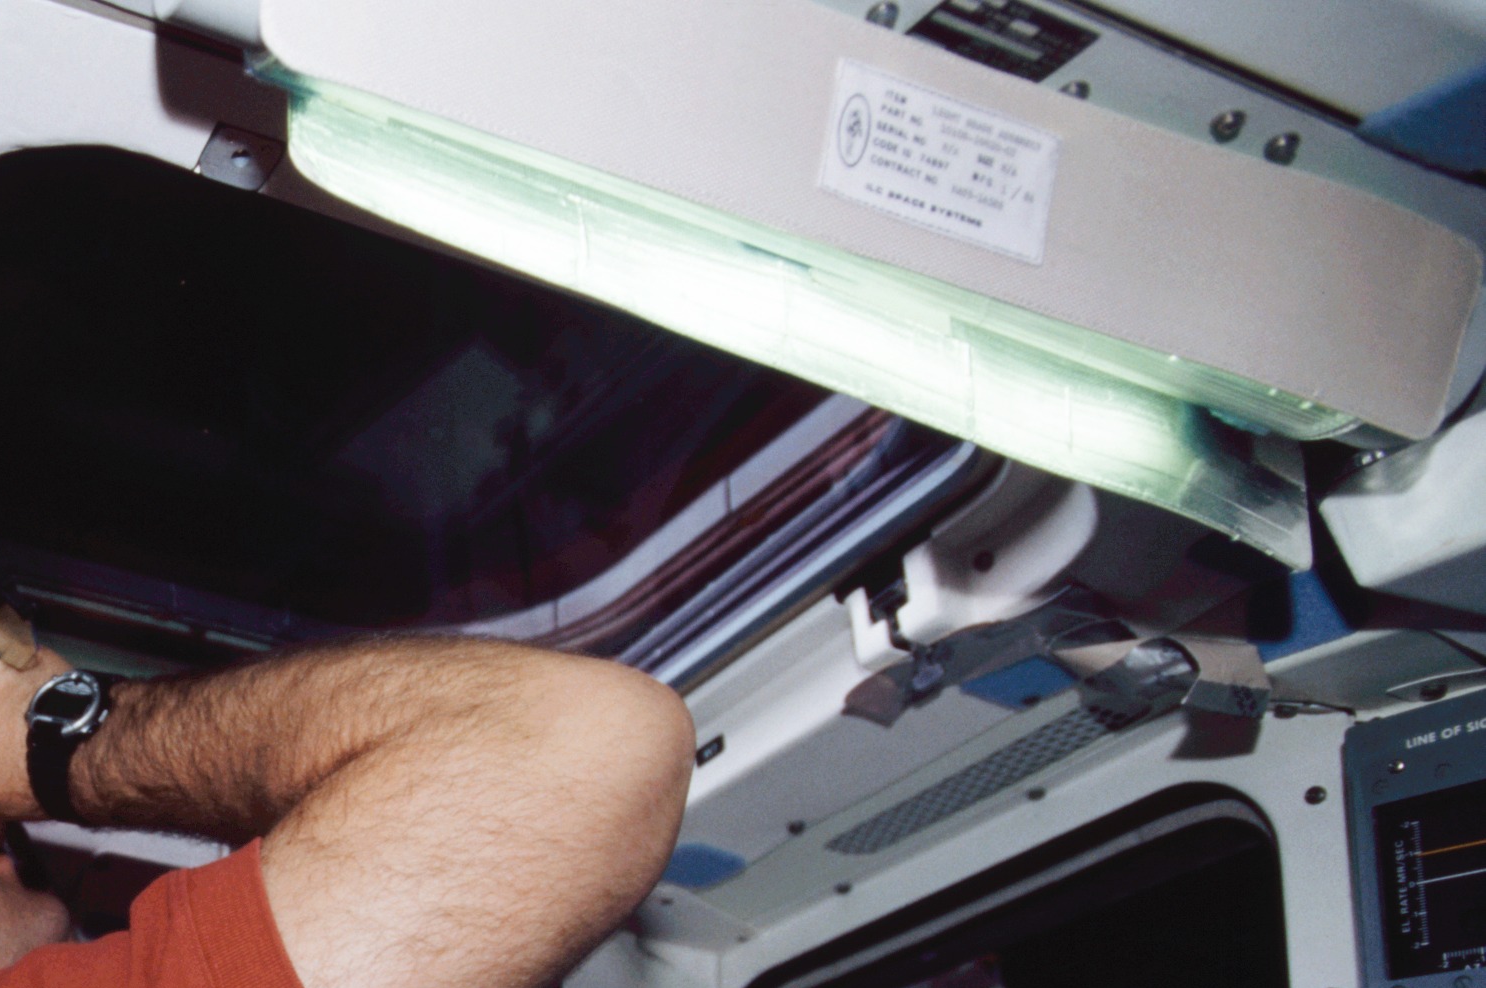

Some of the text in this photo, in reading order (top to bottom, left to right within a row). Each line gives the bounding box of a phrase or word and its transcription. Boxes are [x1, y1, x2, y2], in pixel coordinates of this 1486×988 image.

[880, 104, 905, 120] PART
[876, 120, 908, 140] SERIAL
[872, 137, 898, 154] CODE
[870, 154, 922, 179] CONTRACT
[1405, 730, 1437, 750] LINE
[1440, 724, 1463, 740] OF
